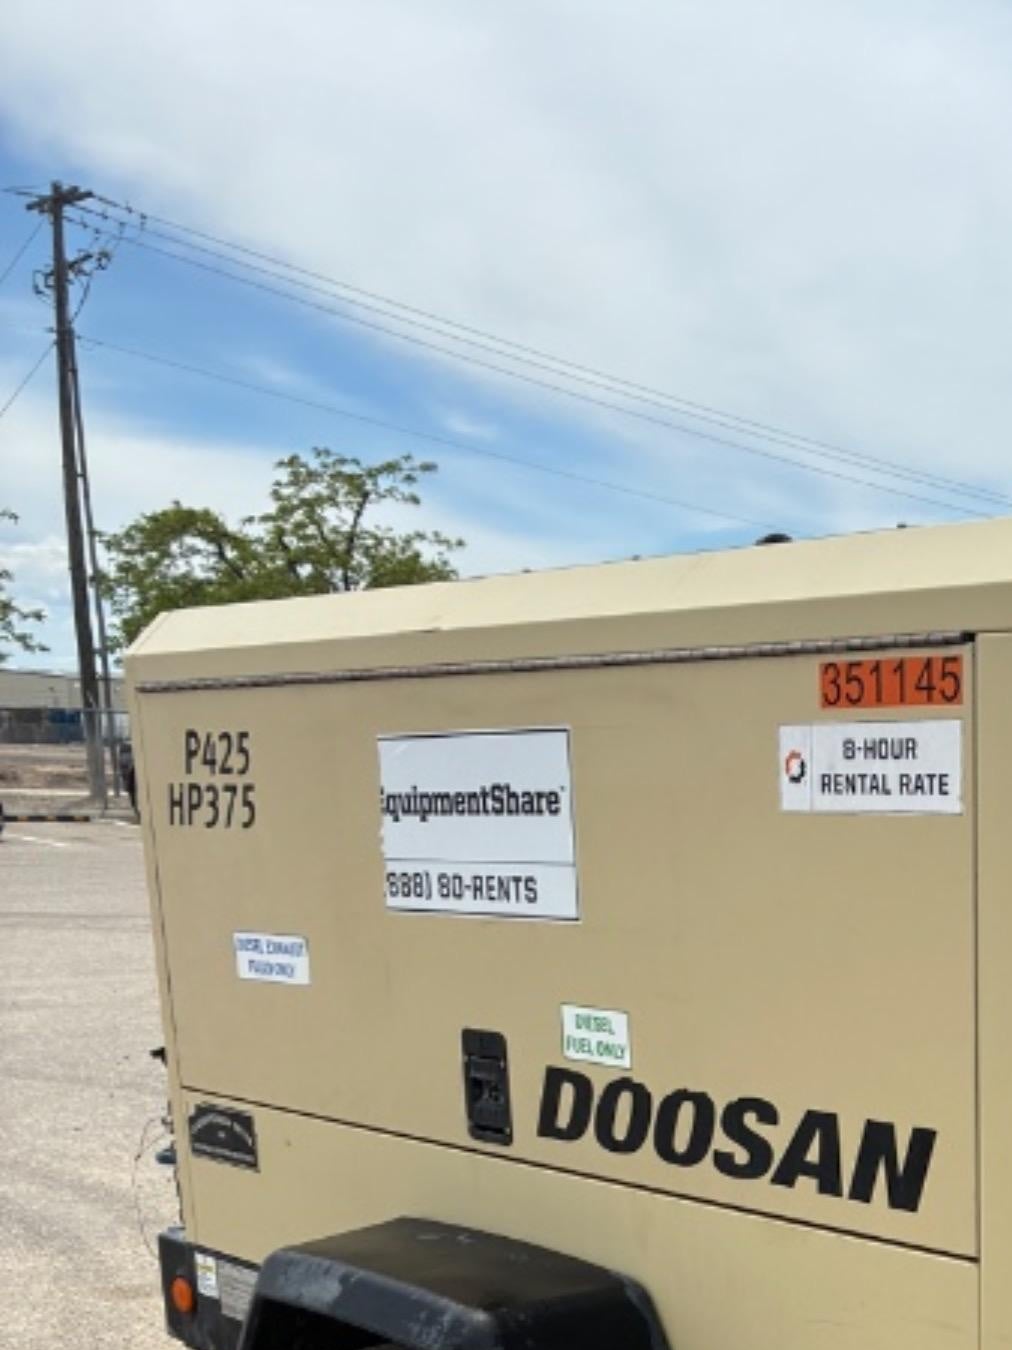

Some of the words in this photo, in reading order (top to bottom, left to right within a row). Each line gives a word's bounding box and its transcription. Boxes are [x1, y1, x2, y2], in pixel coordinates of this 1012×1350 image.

[822, 656, 961, 705] 351145
[184, 729, 250, 775] P425
[842, 738, 917, 760] 8-HOUR
[821, 773, 891, 795] RENTAL
[899, 773, 949, 795] RATE
[168, 783, 255, 829] HP375
[384, 870, 432, 900] 888)
[437, 873, 538, 903] 80-RENTS
[575, 1013, 616, 1035] DIESEL
[567, 1035, 594, 1056] FUEL
[596, 1039, 626, 1060] ONLY
[537, 1065, 937, 1213] DOOSAN
